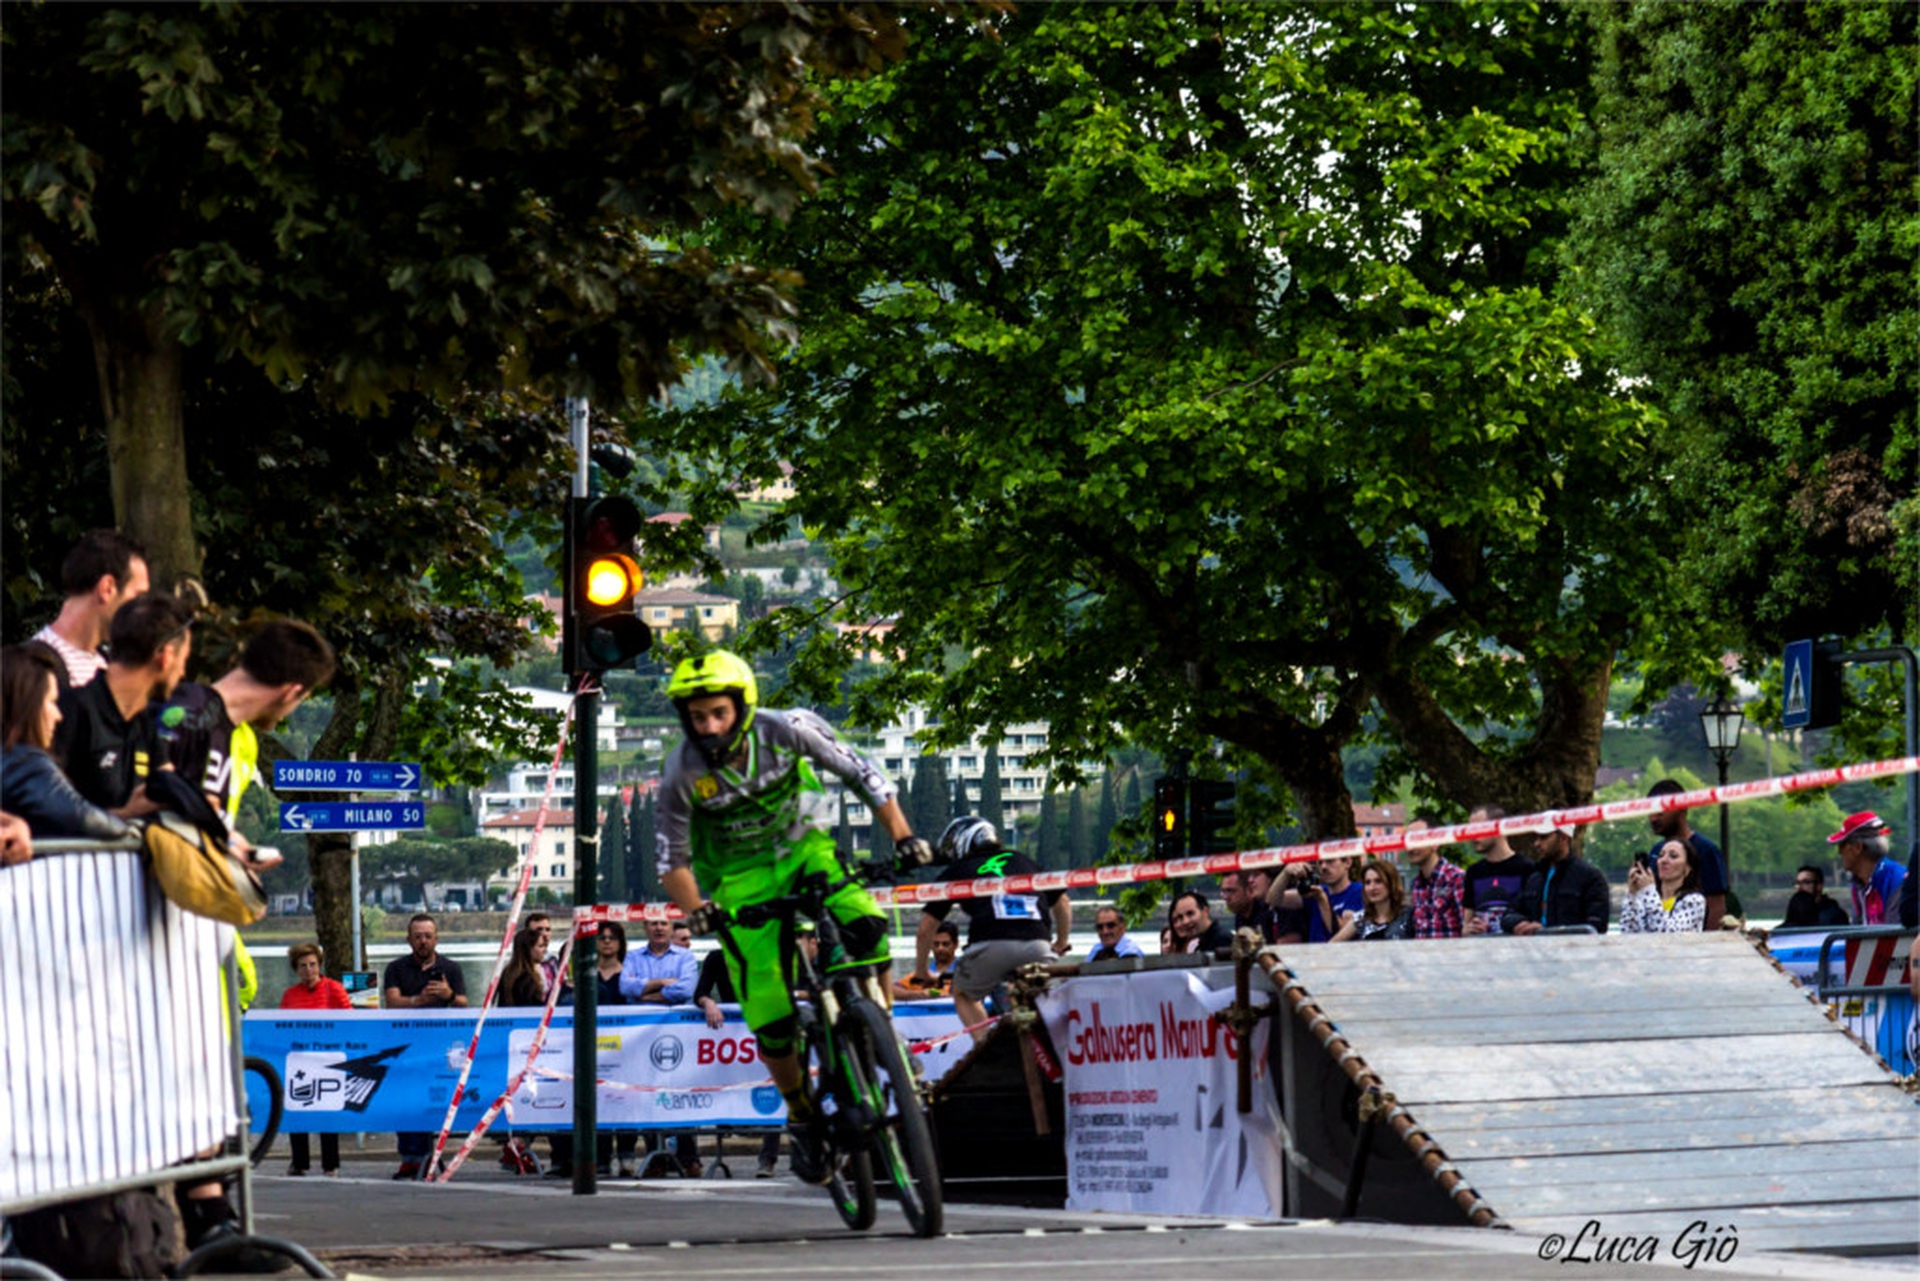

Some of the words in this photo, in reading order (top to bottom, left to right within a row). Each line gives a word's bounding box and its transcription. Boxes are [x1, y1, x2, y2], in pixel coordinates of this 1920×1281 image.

[278, 768, 337, 783] SONDRIO
[346, 769, 363, 783] 70
[344, 809, 393, 823] MILANO
[402, 808, 421, 823] 50
[1068, 1001, 1157, 1066] Galbusera
[697, 1037, 763, 1066] BOS
